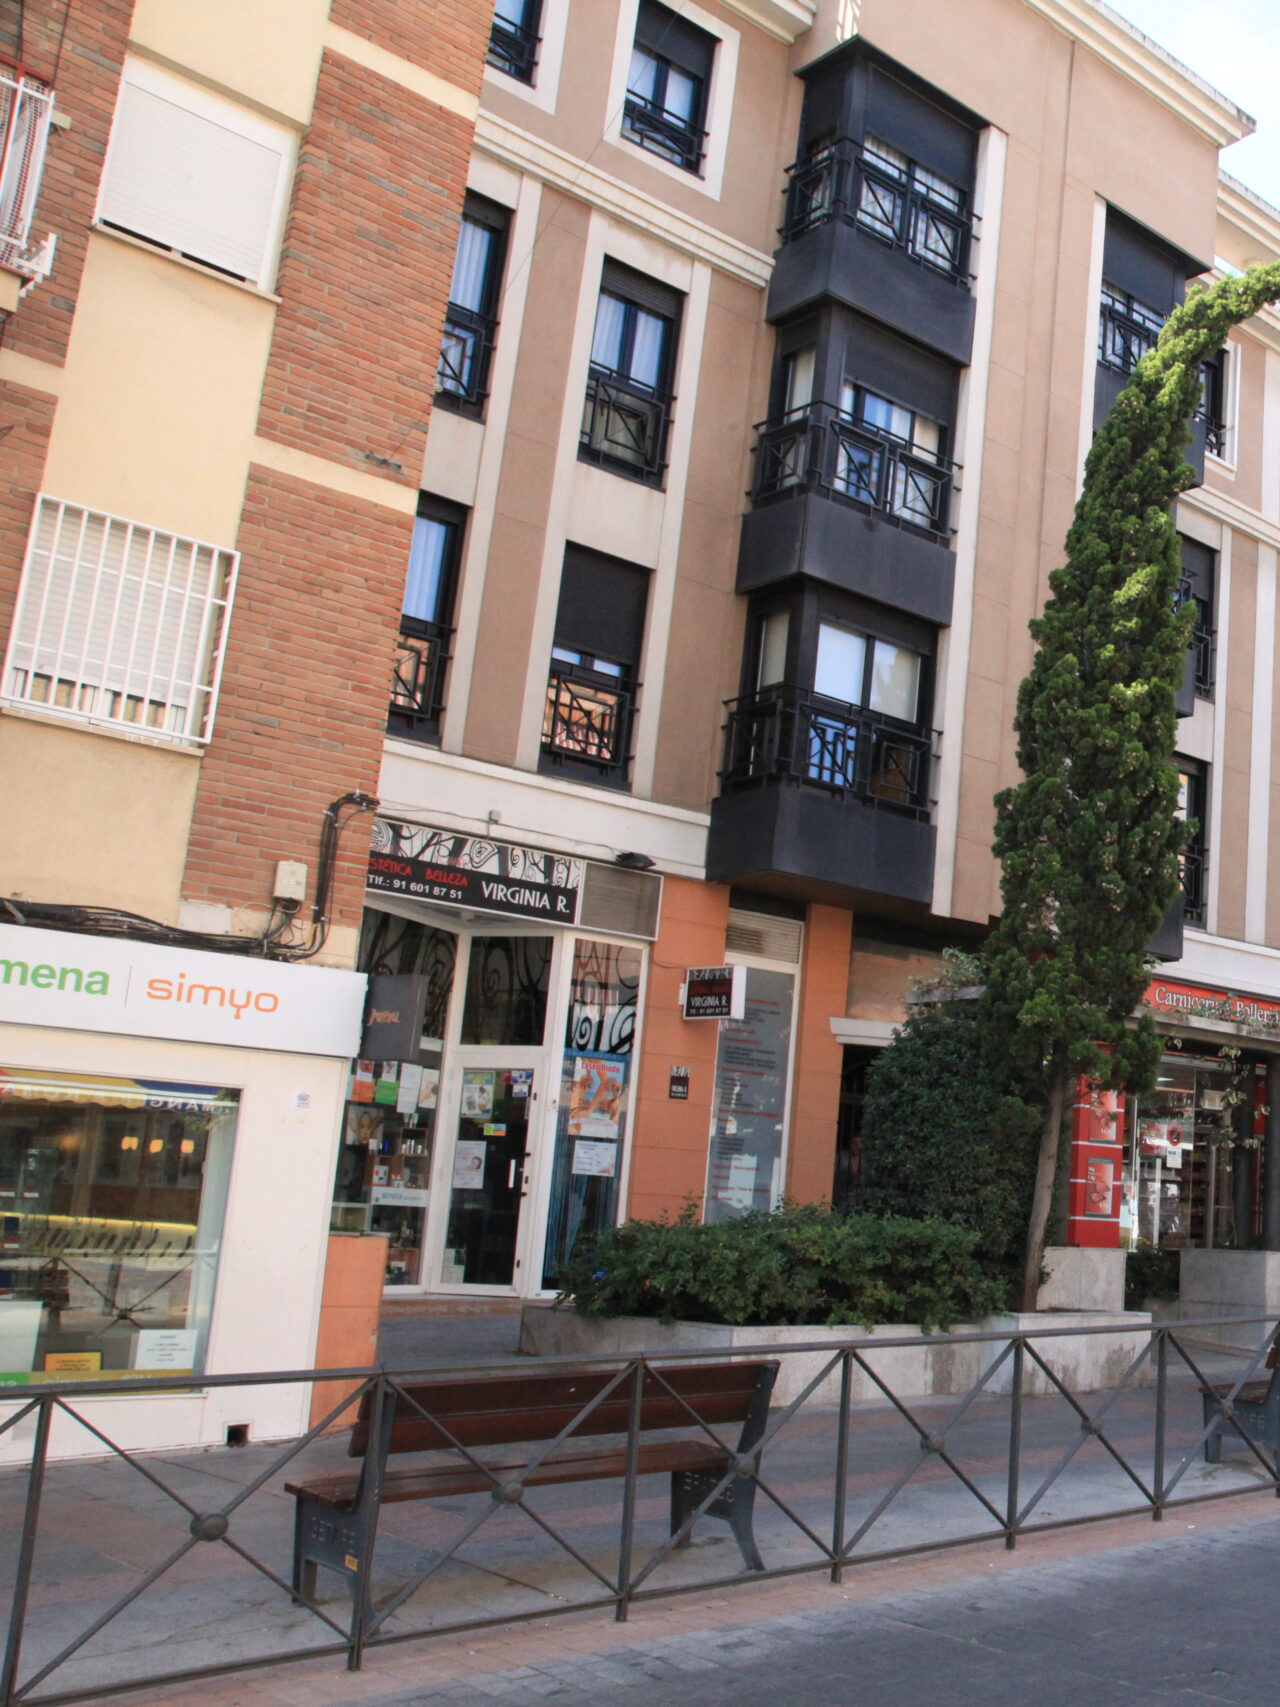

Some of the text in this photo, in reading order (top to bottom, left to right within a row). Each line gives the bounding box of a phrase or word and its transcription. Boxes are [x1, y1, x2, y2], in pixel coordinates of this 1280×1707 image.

[425, 868, 469, 887] BELLEZA
[393, 879, 406, 890] 91
[410, 882, 430, 893] 601
[433, 885, 446, 897] 87
[450, 889, 463, 900] 51
[482, 881, 571, 914] VIRGINIA R.
[146, 972, 280, 1020] simyo
[690, 995, 720, 1007] VIRGINIA
